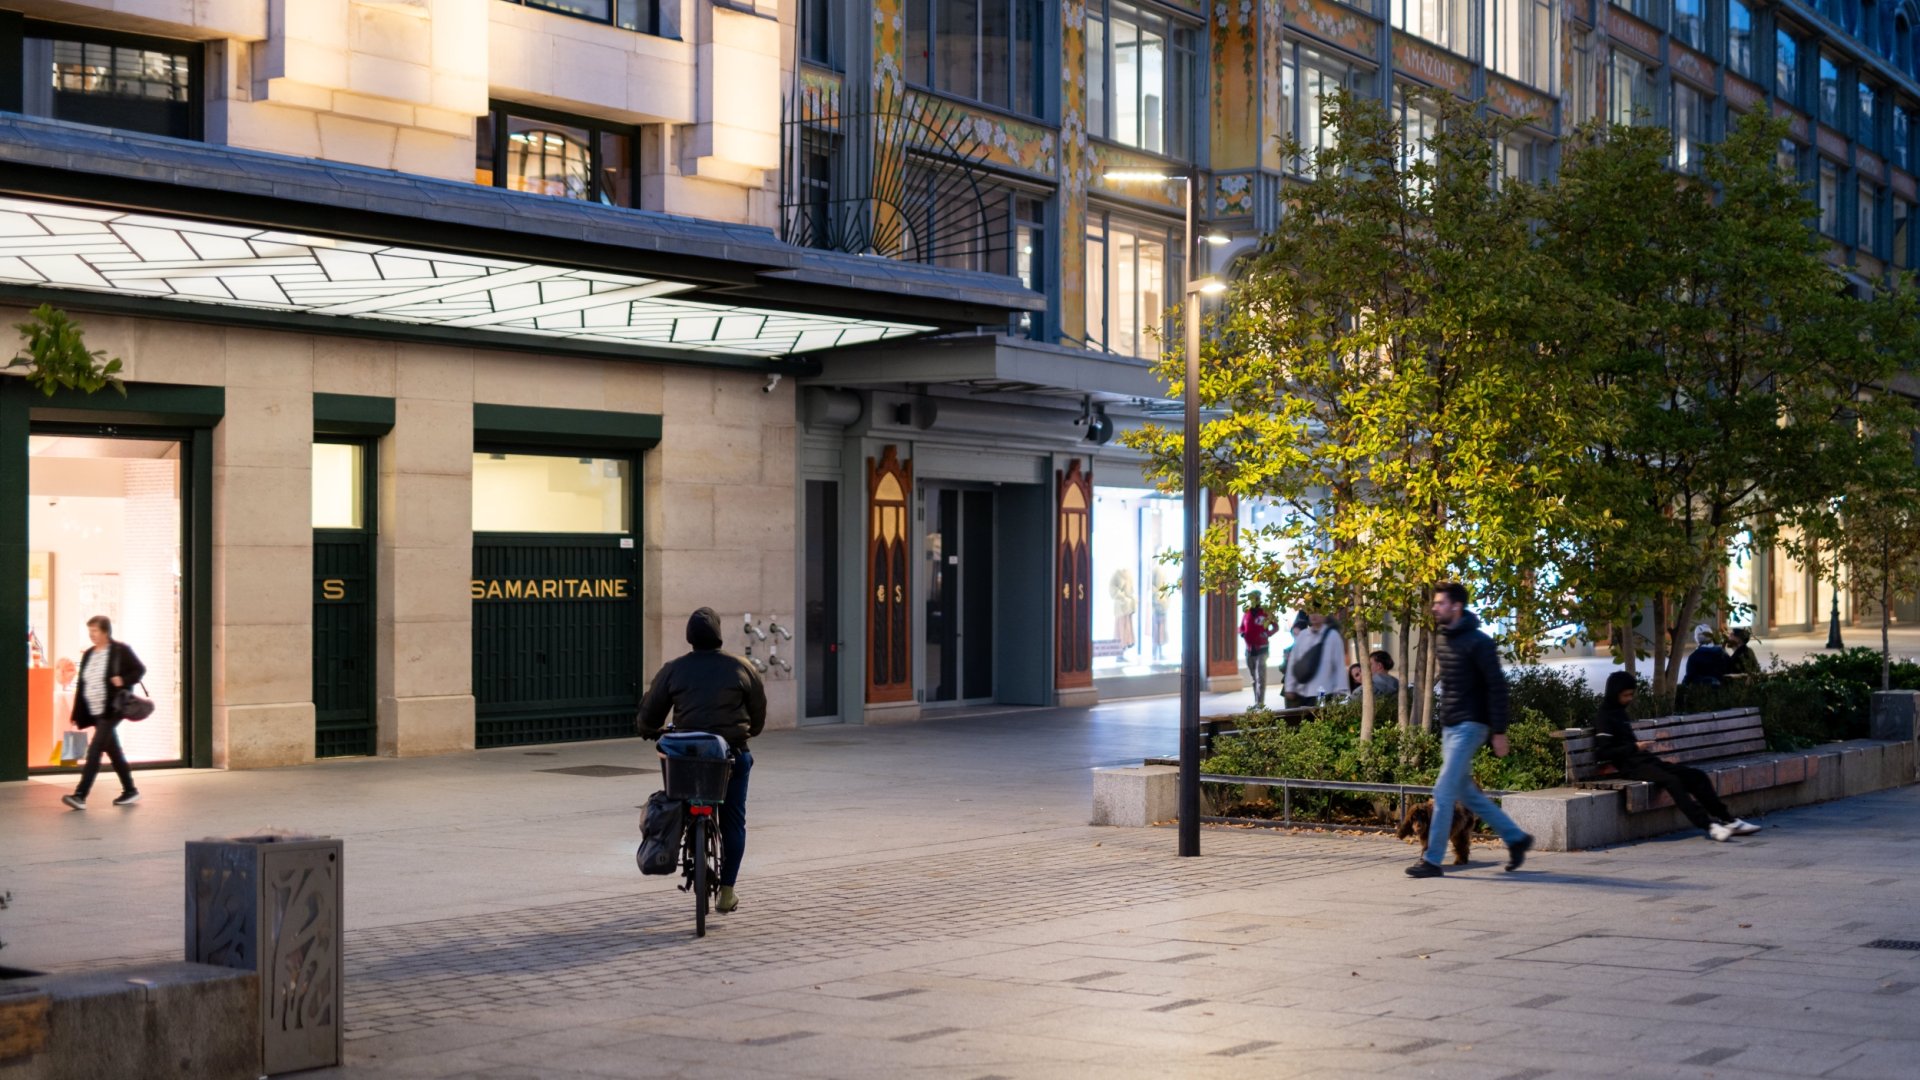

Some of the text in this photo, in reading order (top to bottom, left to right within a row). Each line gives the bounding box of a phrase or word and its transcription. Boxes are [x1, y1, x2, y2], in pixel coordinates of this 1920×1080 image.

[1404, 46, 1456, 86] AMAZONE
[323, 579, 345, 600] S
[471, 579, 628, 599] SAMARITAINE
